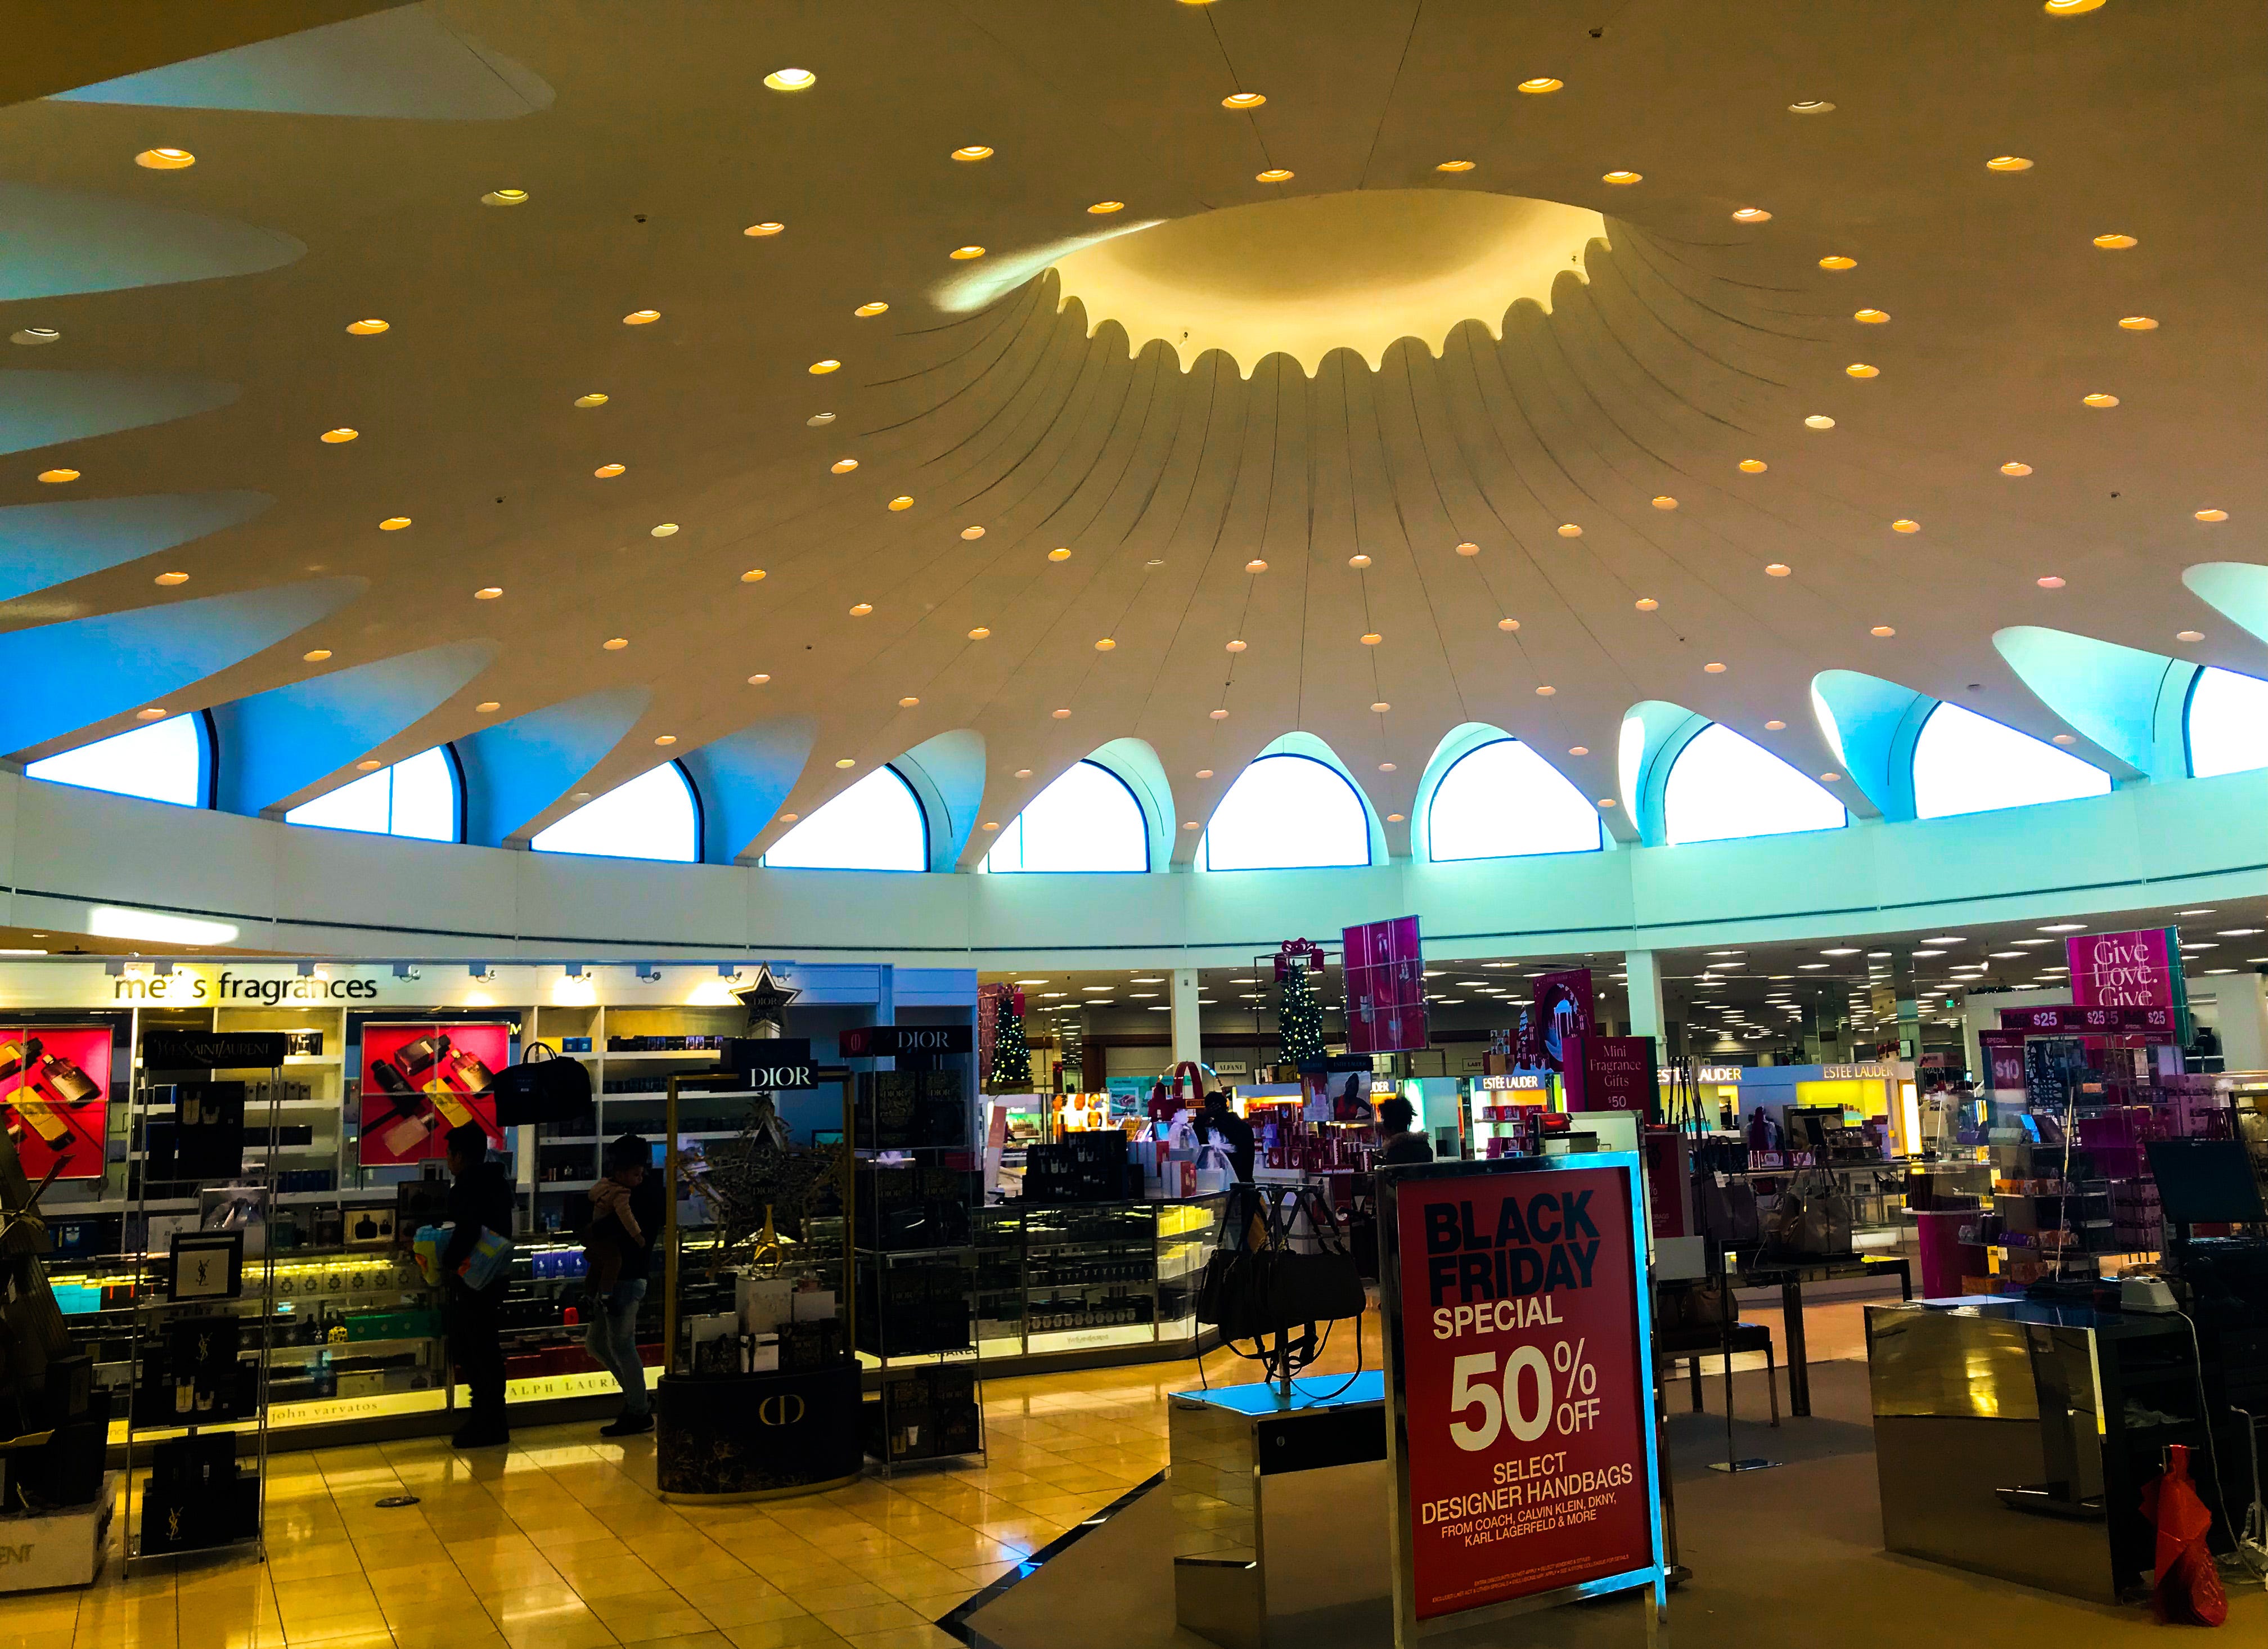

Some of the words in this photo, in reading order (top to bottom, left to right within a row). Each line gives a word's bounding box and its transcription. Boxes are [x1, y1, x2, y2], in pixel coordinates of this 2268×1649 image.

[2094, 939, 2149, 965] Give
[2092, 963, 2158, 987] Love.
[115, 976, 206, 999] mes
[218, 972, 377, 1005] fragrances
[2099, 987, 2153, 1006] Give
[754, 997, 778, 1006] DIOR
[2033, 1012, 2058, 1026] $25
[2087, 1010, 2105, 1025] $25
[2148, 1010, 2166, 1025] $25
[898, 1031, 950, 1048] DIOR
[1604, 1045, 1626, 1057] Mini
[1590, 1059, 1641, 1073] Fragrance
[1657, 1067, 1690, 1082] EST
[1697, 1068, 1742, 1081] AUDER
[1855, 1065, 1893, 1077] LAUDER
[1996, 1059, 2019, 1079] $10
[750, 1066, 811, 1087] DIOR
[1506, 1076, 1538, 1088] LAUDER
[1604, 1074, 1629, 1086] Gifts
[1372, 1081, 1389, 1092] DER
[1608, 1095, 1626, 1107] $50
[1424, 1190, 1600, 1254] BLACK
[1429, 1239, 1600, 1307] FRIDAY
[1433, 1295, 1563, 1339] SPECIAL
[510, 1384, 554, 1395] ALPH
[565, 1378, 619, 1391] LAURE
[272, 1408, 306, 1423] john
[314, 1403, 378, 1415] varvatos
[1557, 1398, 1600, 1435] OFF
[1493, 1452, 1567, 1485] SELECT
[1422, 1485, 1522, 1525] DESIGNER
[1527, 1463, 1633, 1503] HANDBAGS
[1442, 1521, 1473, 1538] FROM
[1475, 1514, 1515, 1531] COACH,
[1518, 1504, 1553, 1522] CALVIN
[1555, 1498, 1586, 1515] KLEIN,
[1588, 1491, 1617, 1509] DKNY,
[1464, 1533, 1494, 1548] KARL
[1496, 1520, 1556, 1542] LAGERFELD
[1558, 1517, 1565, 1527] &
[1568, 1509, 1597, 1526] MORE
